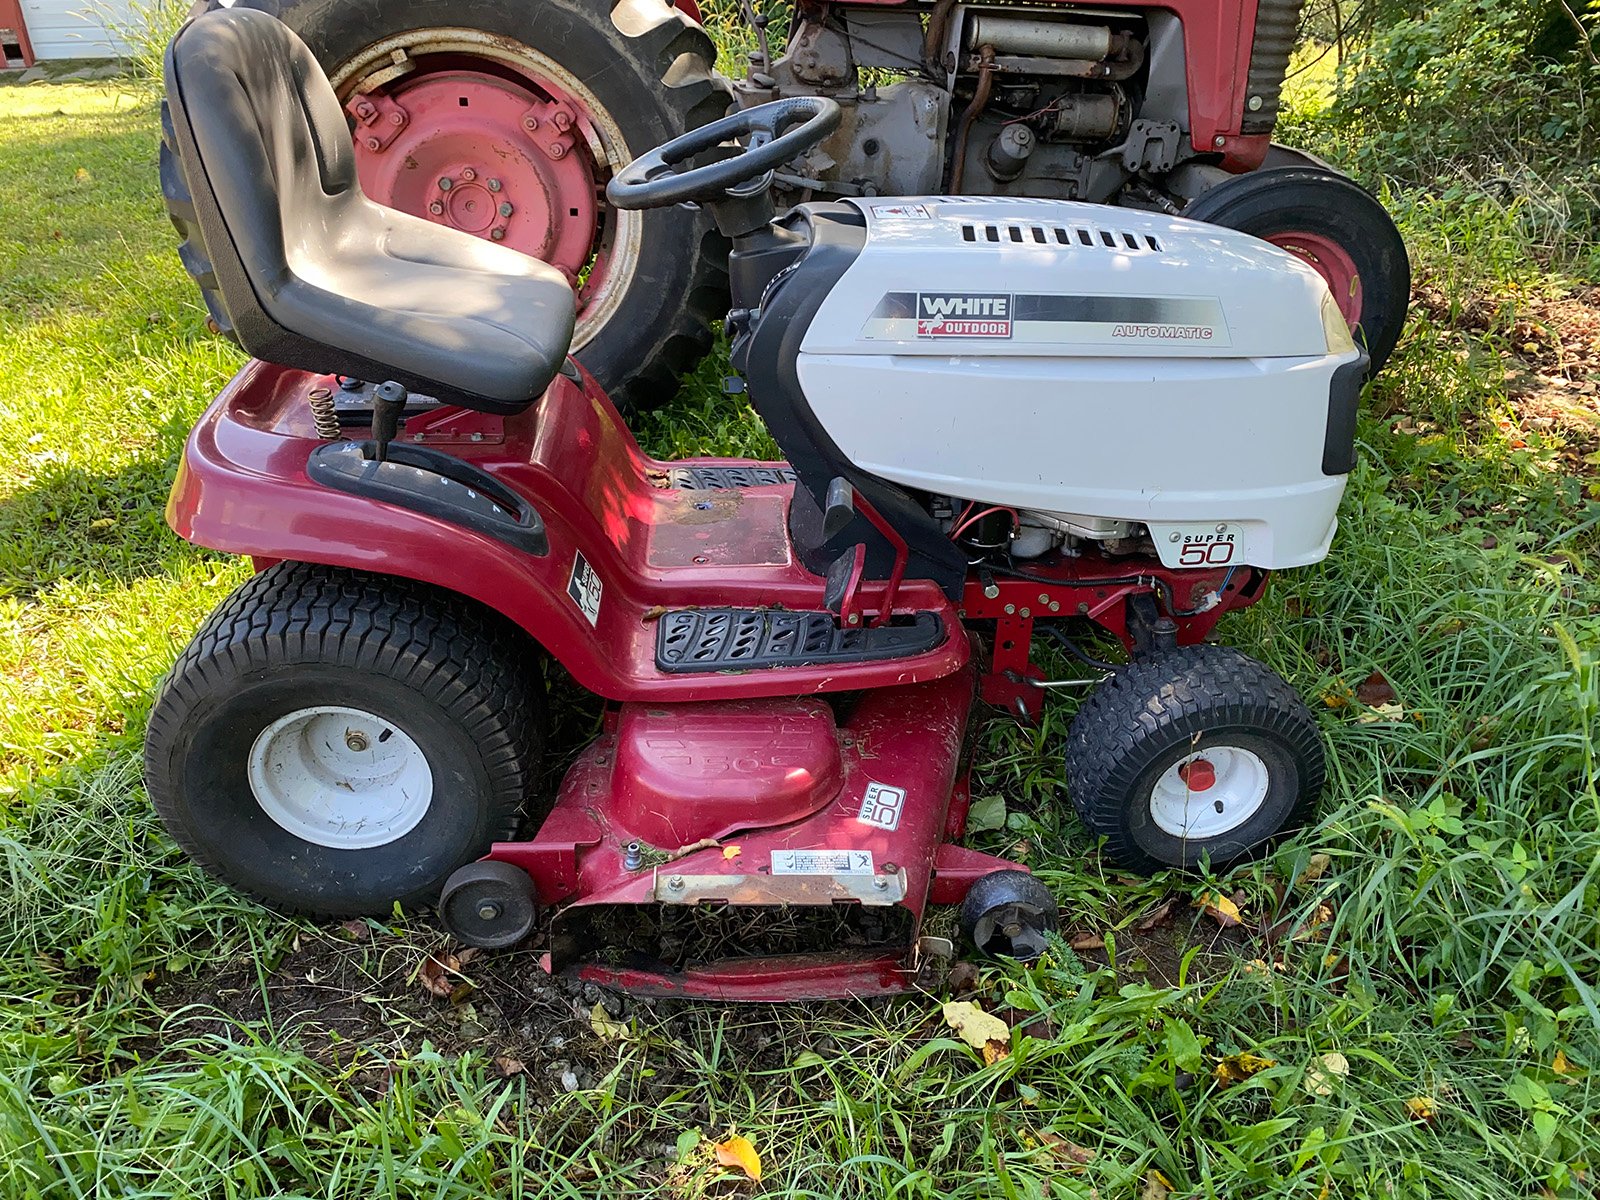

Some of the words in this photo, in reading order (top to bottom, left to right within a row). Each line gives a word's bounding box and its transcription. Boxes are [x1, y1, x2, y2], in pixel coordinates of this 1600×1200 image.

[922, 297, 1007, 316] WHITE
[945, 322, 1007, 334] OUTDOOR
[1111, 325, 1213, 340] AUTOMATIC
[1183, 534, 1235, 543] SUPER
[1179, 542, 1235, 566] 50
[862, 787, 879, 820] SUPER
[870, 789, 901, 826] 50
